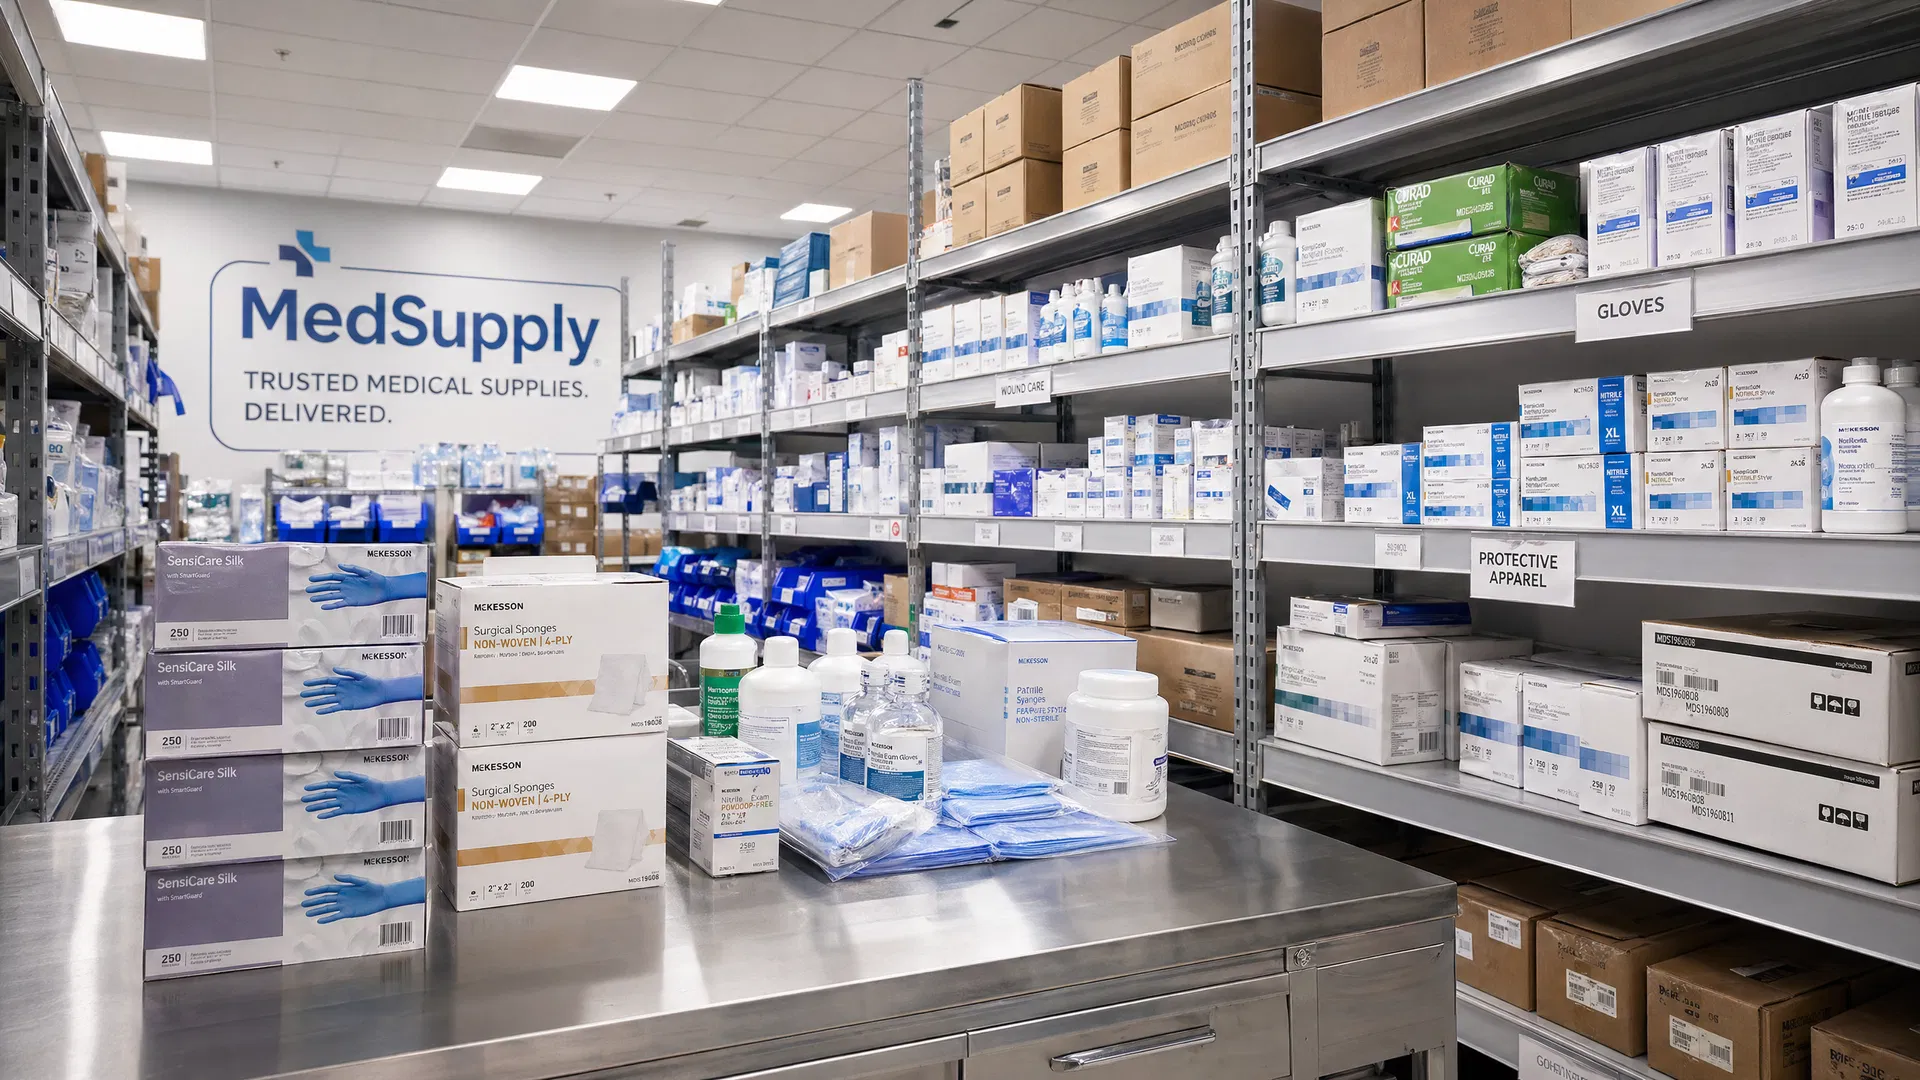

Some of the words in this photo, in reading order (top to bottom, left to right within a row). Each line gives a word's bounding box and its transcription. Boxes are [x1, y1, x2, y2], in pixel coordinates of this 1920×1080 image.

[1467, 174, 1495, 188] CURAD
[1395, 184, 1431, 204] CURAD
[1468, 242, 1496, 255] CURAD
[1395, 250, 1431, 268] CURAD
[1597, 296, 1664, 320] GLOVES
[241, 286, 600, 366] MedSupply
[244, 371, 358, 392] TRUSTED
[367, 375, 472, 395] MEDICAL
[481, 378, 588, 399] SUPPLIES.
[1001, 383, 1026, 396] WOUND
[1027, 380, 1045, 392] CARE
[245, 402, 392, 424] DELIVERED.
[1605, 428, 1620, 438] XL
[1496, 459, 1506, 467] XL
[1406, 491, 1416, 500] XL
[1496, 511, 1506, 519] XL
[1611, 505, 1626, 516] XL
[167, 554, 222, 566] SensiCare
[225, 554, 244, 566] Silk
[1479, 551, 1558, 570] PROTECTIVE
[1489, 571, 1547, 588] APPAREL
[170, 628, 189, 638] 250
[474, 625, 513, 637] Surgical
[515, 624, 557, 636] Sponges
[474, 637, 537, 649] NON-WOVEN
[544, 636, 573, 646] 4-PLY
[157, 661, 214, 673] SensiCare
[216, 660, 236, 672] Silk
[1685, 702, 1729, 717] MDS1960808
[523, 720, 537, 728] 200
[162, 736, 182, 746] 250
[157, 768, 214, 782] SensiCare
[217, 767, 237, 779] Silk
[472, 785, 511, 797] Surgical
[513, 782, 555, 794] Sponges
[472, 796, 535, 810] NON-WOVEN
[543, 792, 571, 804] 4-PLY
[1691, 805, 1734, 822] MDS1960811
[162, 845, 182, 855] 250
[157, 874, 215, 889] SensiCare
[217, 873, 237, 885] Silk
[520, 880, 535, 889] 200
[161, 953, 181, 964] 250
